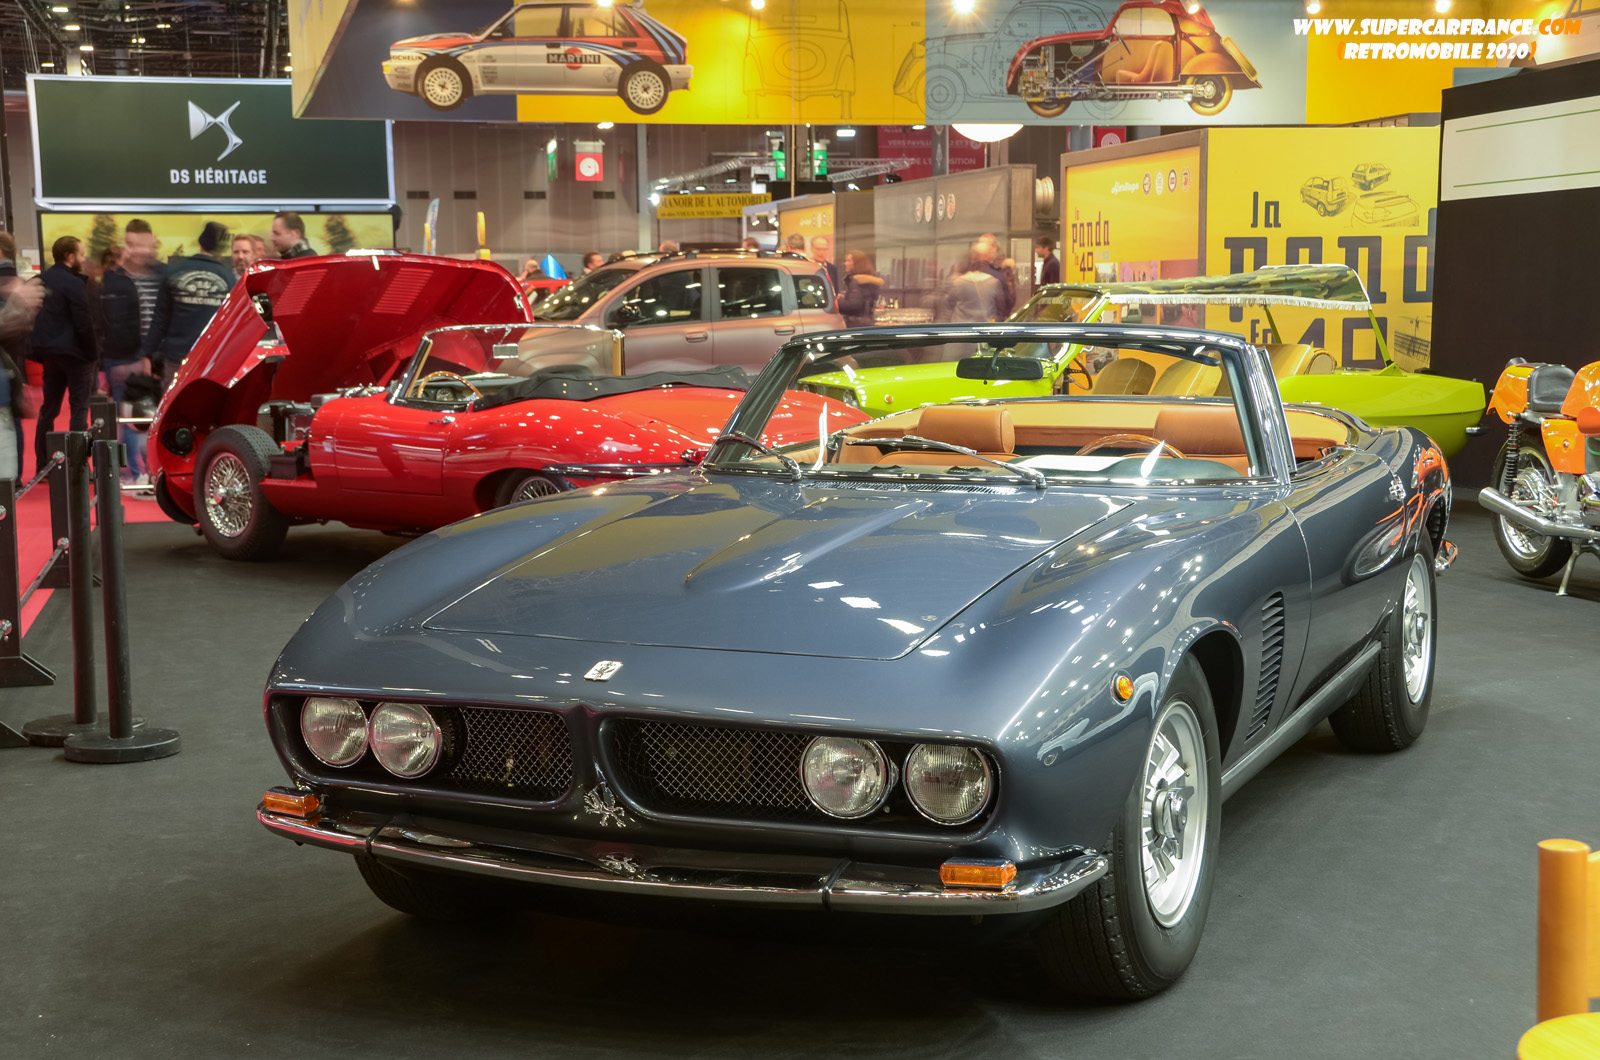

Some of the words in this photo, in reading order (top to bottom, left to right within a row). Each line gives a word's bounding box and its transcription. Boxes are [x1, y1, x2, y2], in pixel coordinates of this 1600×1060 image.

[548, 54, 600, 63] MARTINI
[170, 169, 190, 184] DS
[195, 166, 267, 184] HÉRITAGE
[695, 196, 705, 207] DE
[1079, 251, 1094, 281] 40
